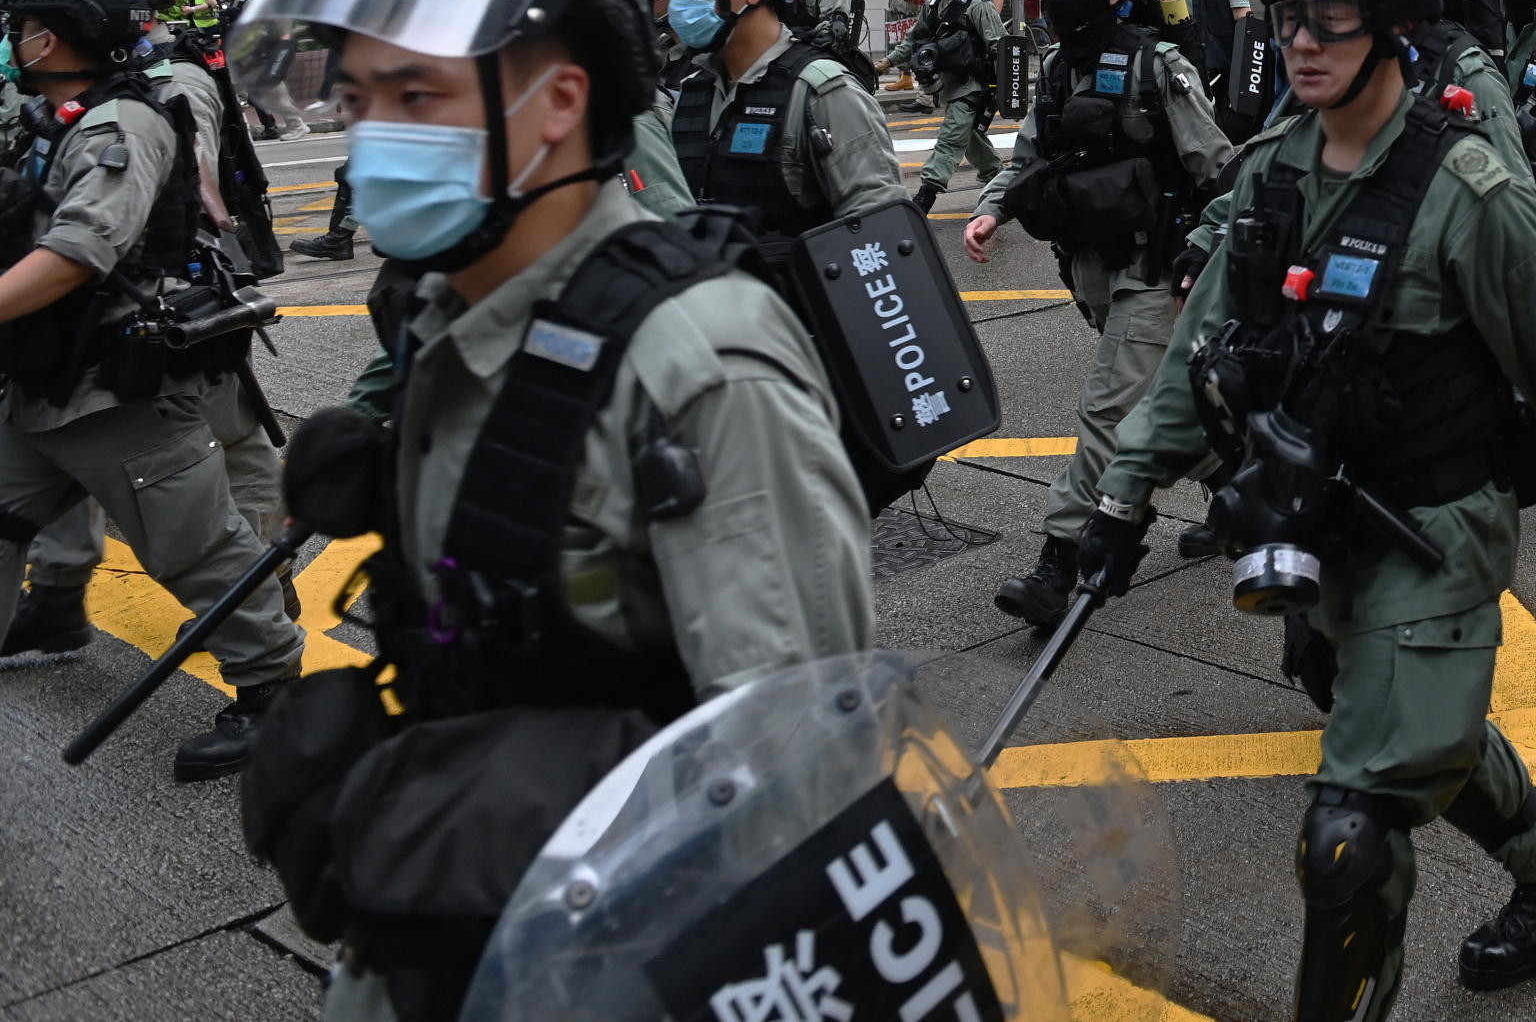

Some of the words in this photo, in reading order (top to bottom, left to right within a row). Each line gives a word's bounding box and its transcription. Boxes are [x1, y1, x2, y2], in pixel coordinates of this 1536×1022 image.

[1012, 57, 1020, 97] POLICE
[1249, 40, 1265, 94] POLICE
[1349, 237, 1378, 253] POLICE
[865, 274, 935, 392] POLICE
